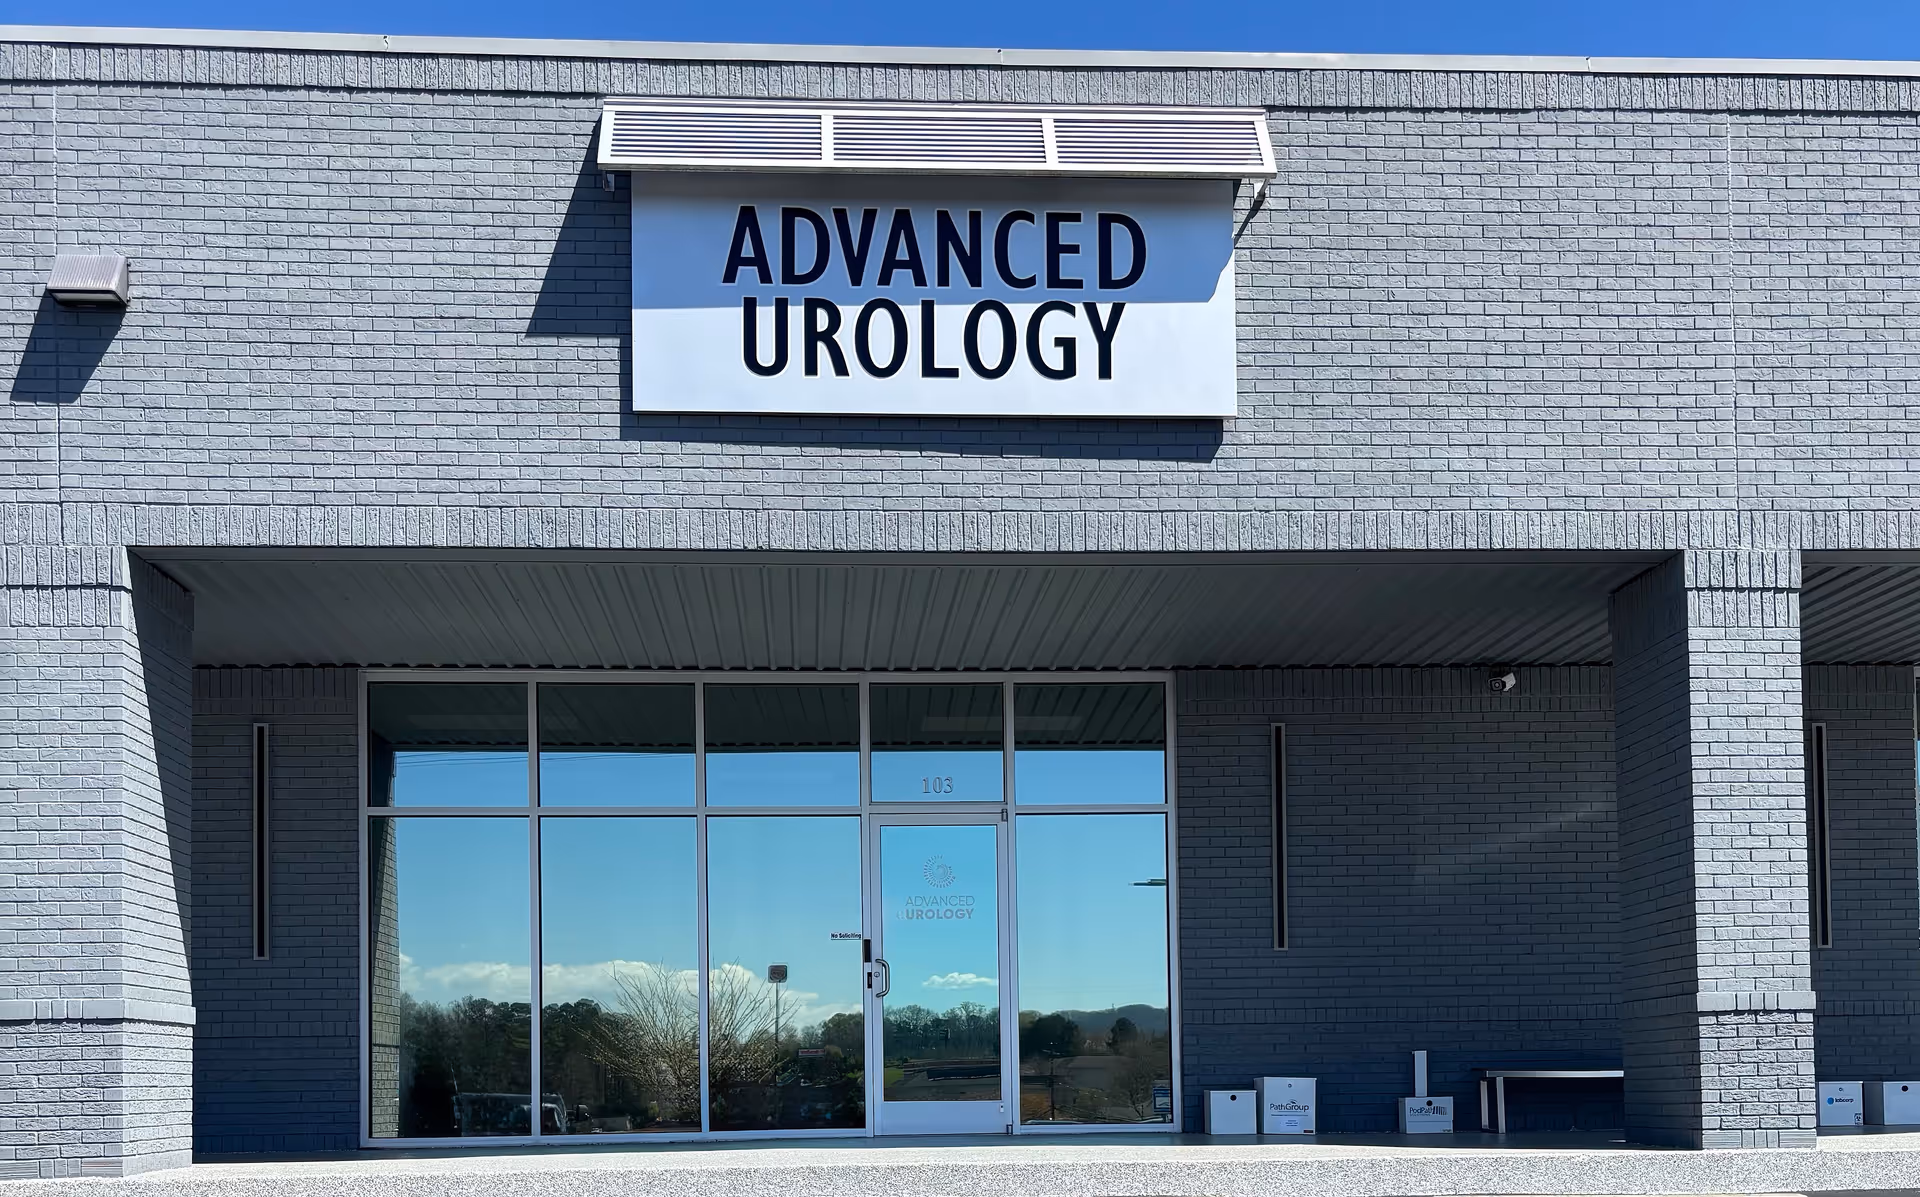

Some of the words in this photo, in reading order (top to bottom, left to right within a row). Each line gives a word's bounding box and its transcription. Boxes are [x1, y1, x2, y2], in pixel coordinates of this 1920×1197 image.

[722, 205, 1147, 290] ADVANCED
[742, 296, 1127, 380] UROLOGY
[922, 776, 953, 793] 103
[905, 895, 975, 906] ADVANCED
[905, 908, 974, 920] UROLOGY
[1269, 1103, 1309, 1112] PathGroup
